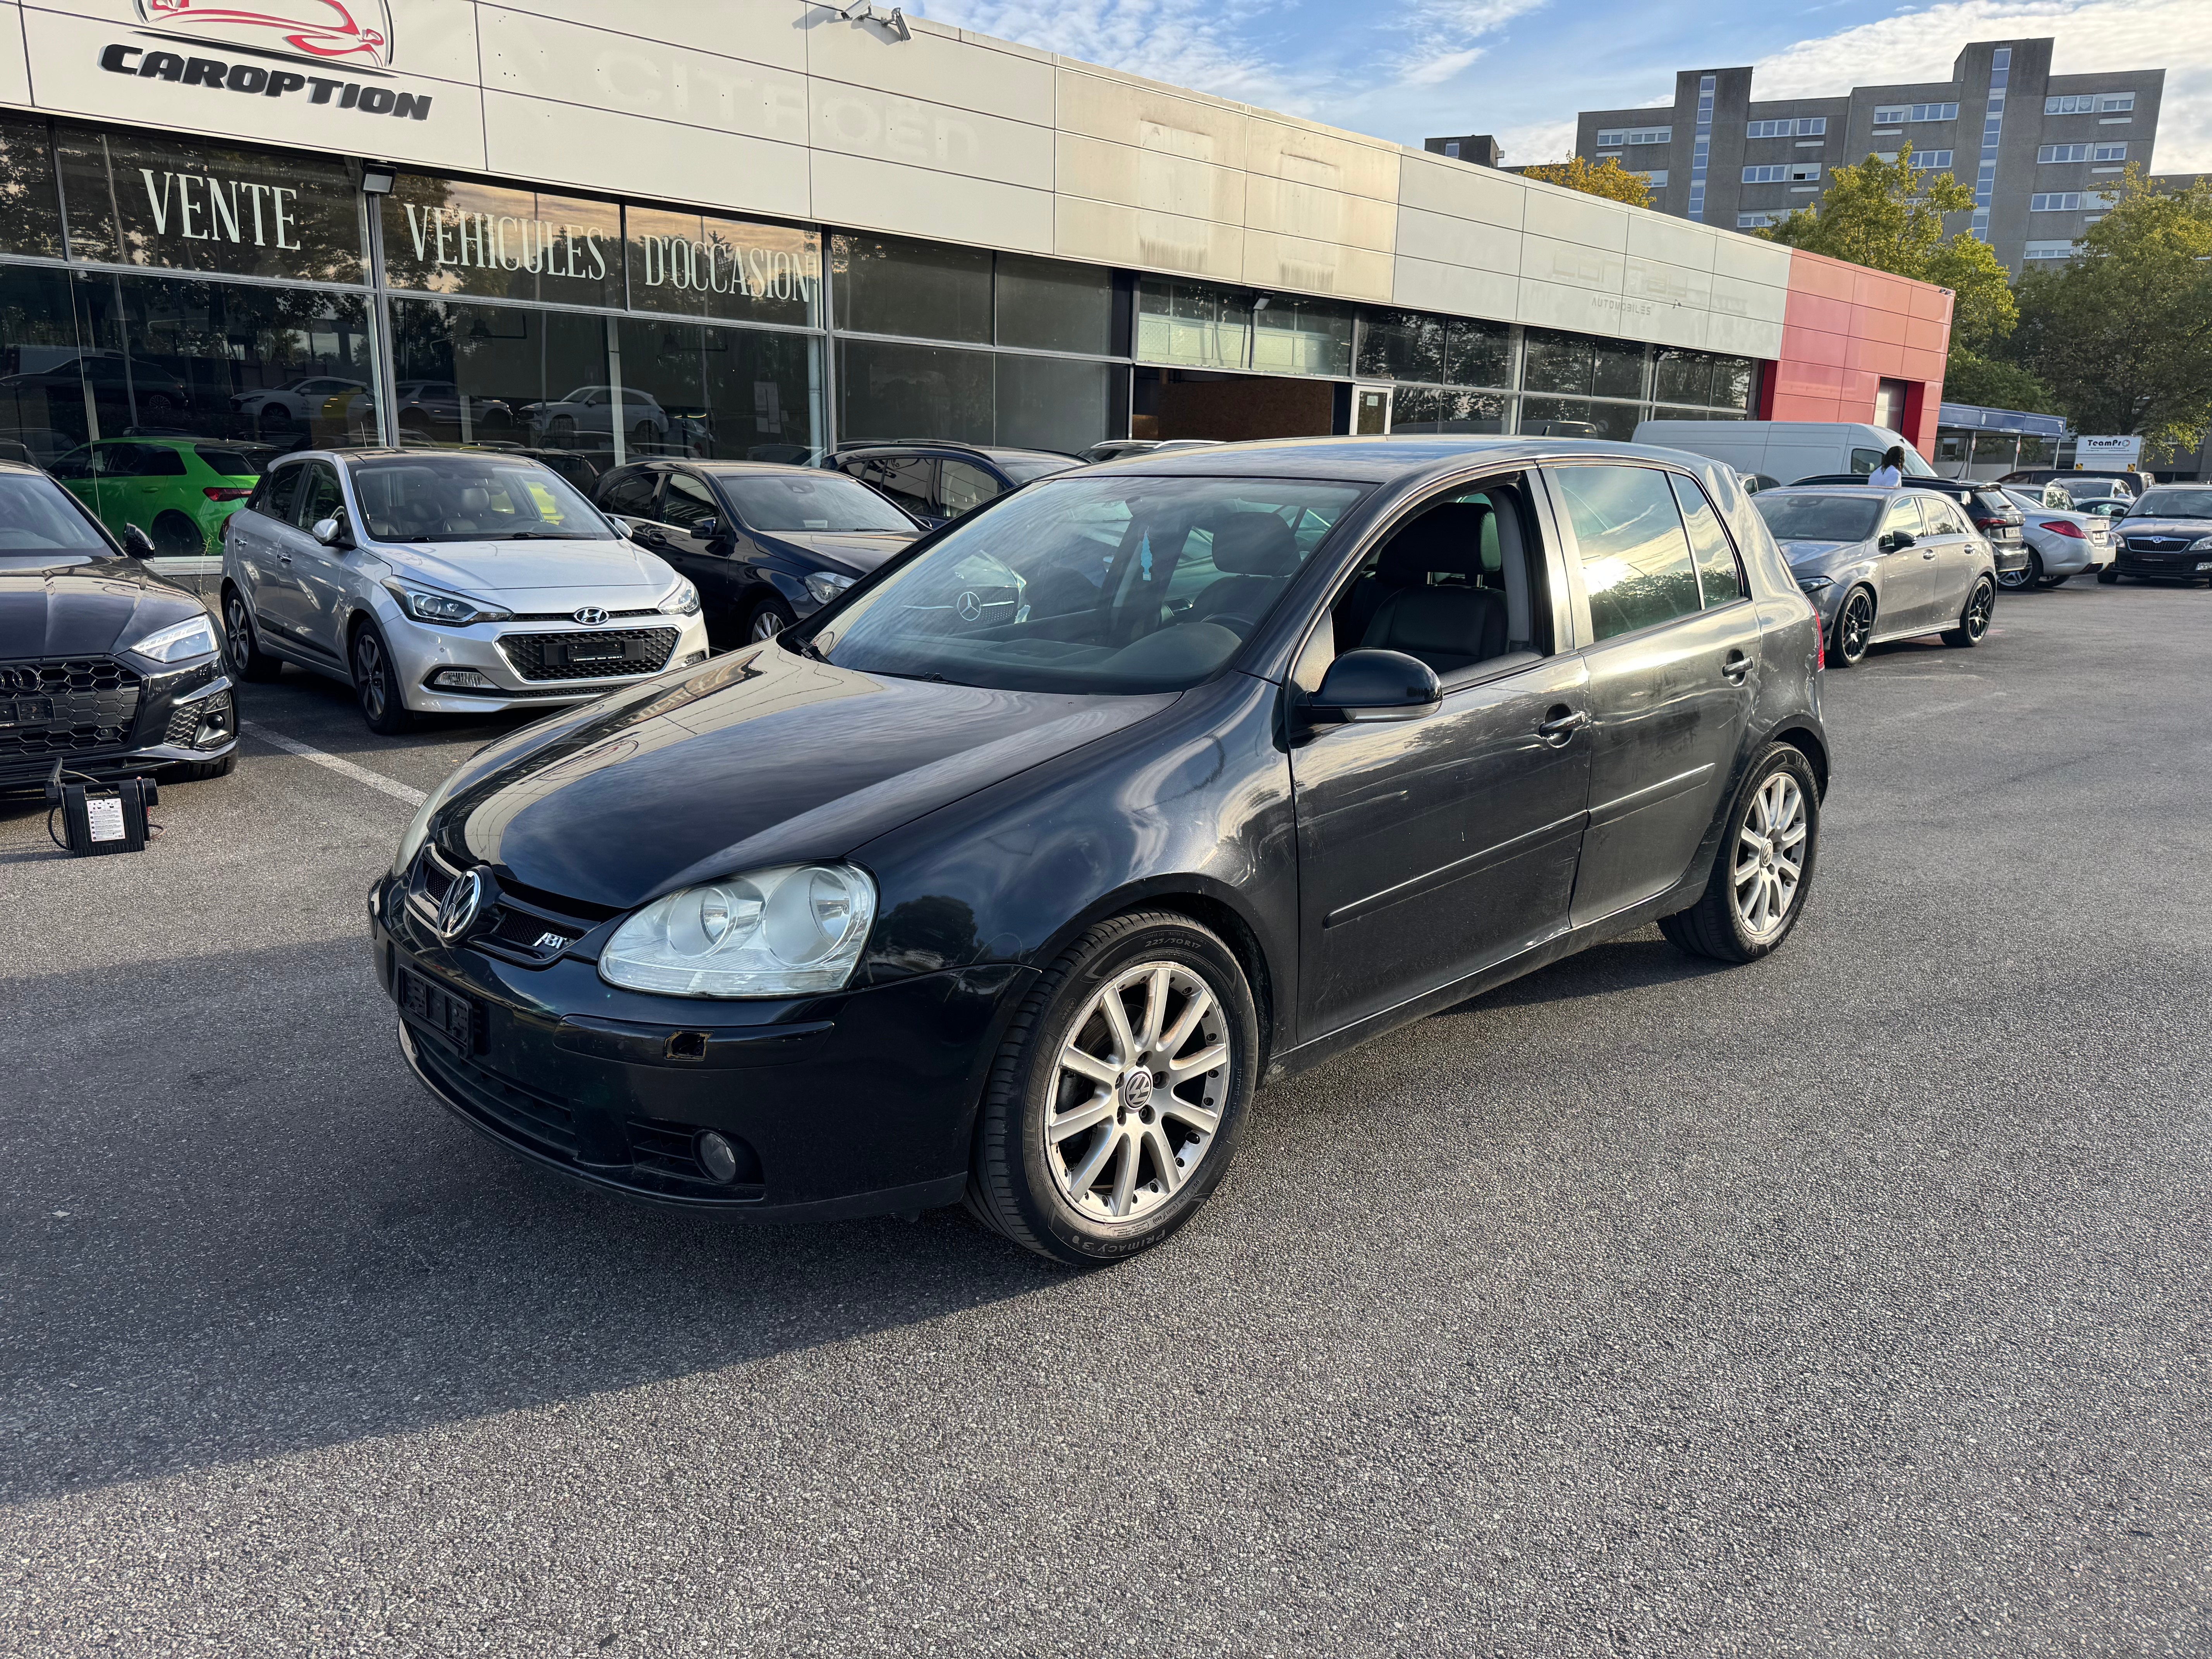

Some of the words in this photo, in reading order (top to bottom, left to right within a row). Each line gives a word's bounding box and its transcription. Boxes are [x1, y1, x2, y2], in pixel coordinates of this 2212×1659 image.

[100, 44, 433, 120] CAROPTION
[139, 168, 301, 251] VENTE
[403, 203, 606, 281] VEHICULES
[643, 234, 810, 302] D'OCCASION
[1591, 297, 1651, 315] AUTOMOBILES
[1801, 761, 1820, 811] MICHELIN
[532, 932, 567, 949] ABT
[1024, 1033, 1056, 1161] MICHELIN
[1082, 1242, 1094, 1250] 3
[1097, 1229, 1166, 1253] PRIMACY
